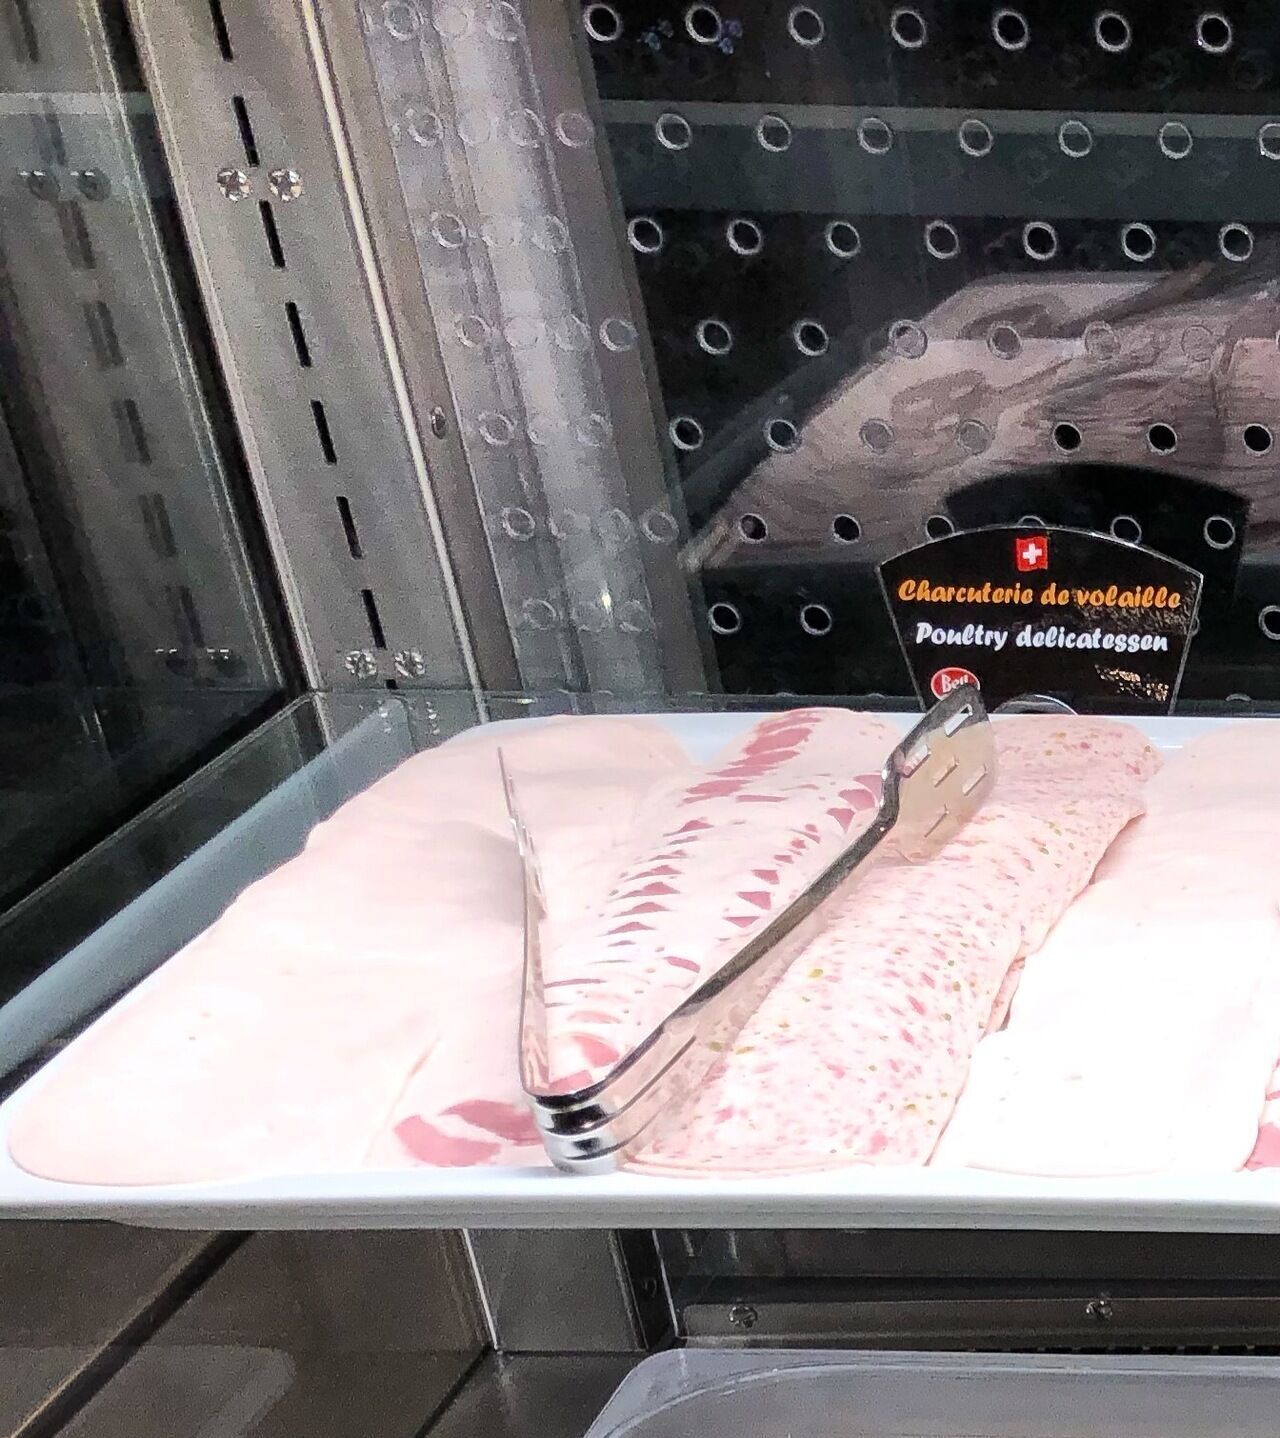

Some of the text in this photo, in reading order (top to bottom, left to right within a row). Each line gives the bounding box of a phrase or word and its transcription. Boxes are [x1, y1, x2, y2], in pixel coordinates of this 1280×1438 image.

[899, 579, 1182, 609] Charcuterie de volaille
[916, 622, 1169, 652] Poultry delicatessen
